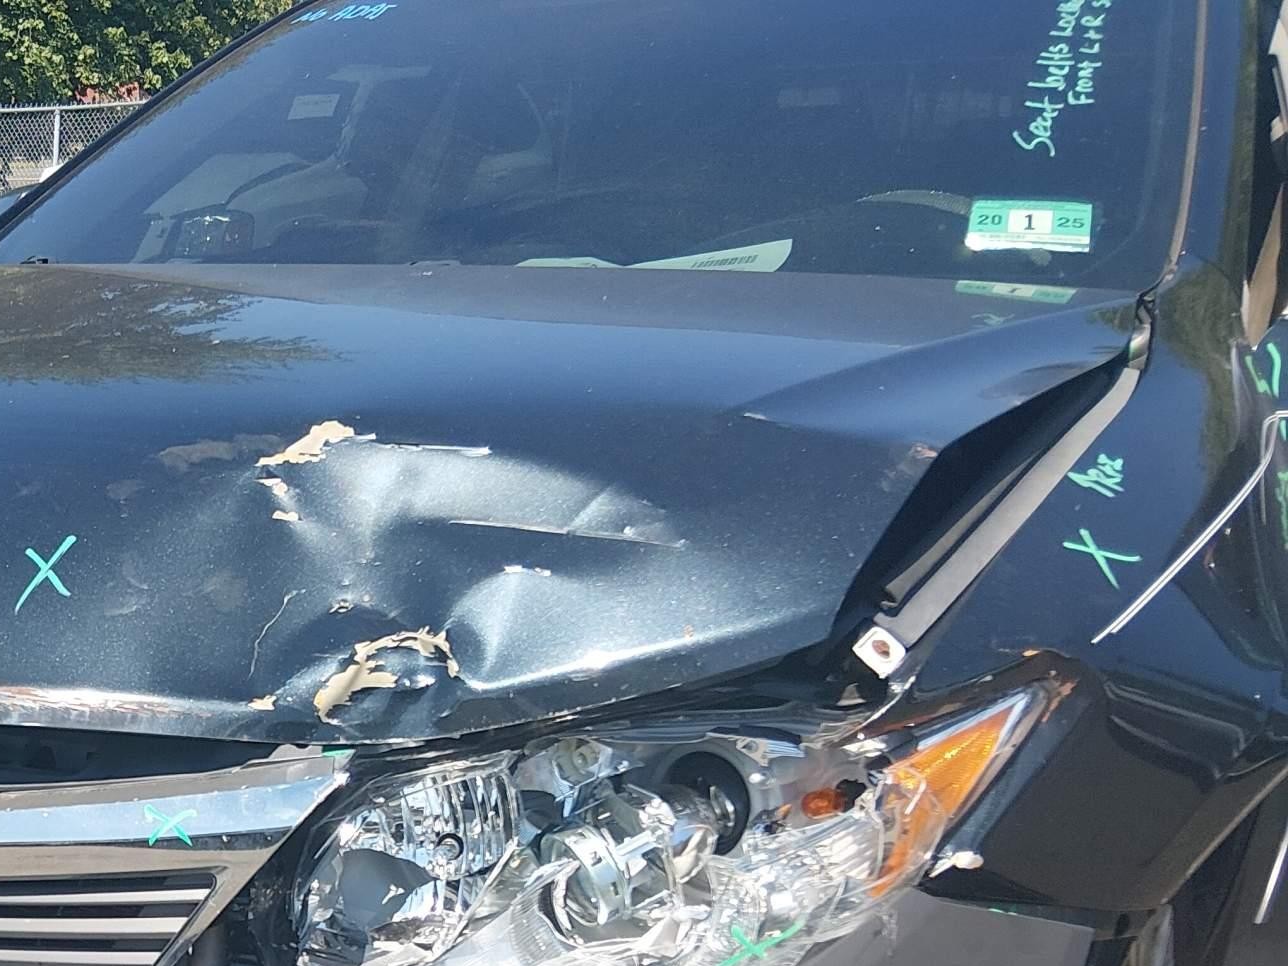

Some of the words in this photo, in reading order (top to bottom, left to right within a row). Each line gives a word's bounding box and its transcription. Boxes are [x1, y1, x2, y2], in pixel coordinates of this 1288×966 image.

[1026, 43, 1075, 91] belts
[1012, 95, 1065, 157] Seat
[977, 213, 1003, 226] 20
[1023, 213, 1036, 231] 1
[1056, 216, 1085, 229] 25
